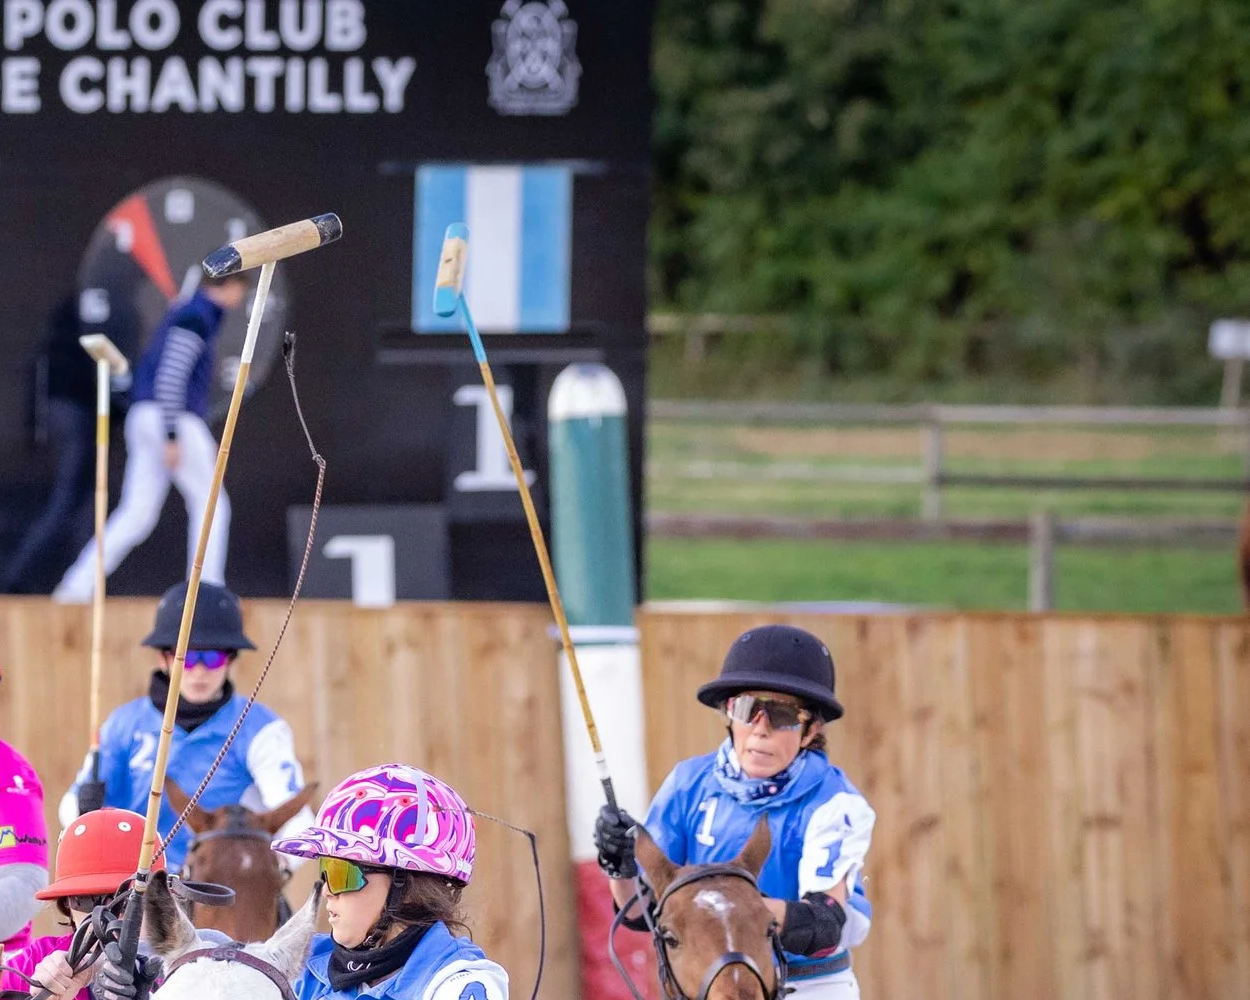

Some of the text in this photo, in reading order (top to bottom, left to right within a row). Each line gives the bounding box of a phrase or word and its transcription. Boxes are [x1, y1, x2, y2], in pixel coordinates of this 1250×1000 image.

[3, 0, 367, 51] POLO CLUB
[59, 56, 417, 114] CHANTILLY
[453, 384, 537, 492] 1
[322, 534, 396, 608] 1
[696, 797, 719, 847] 1
[815, 838, 844, 878] 1
